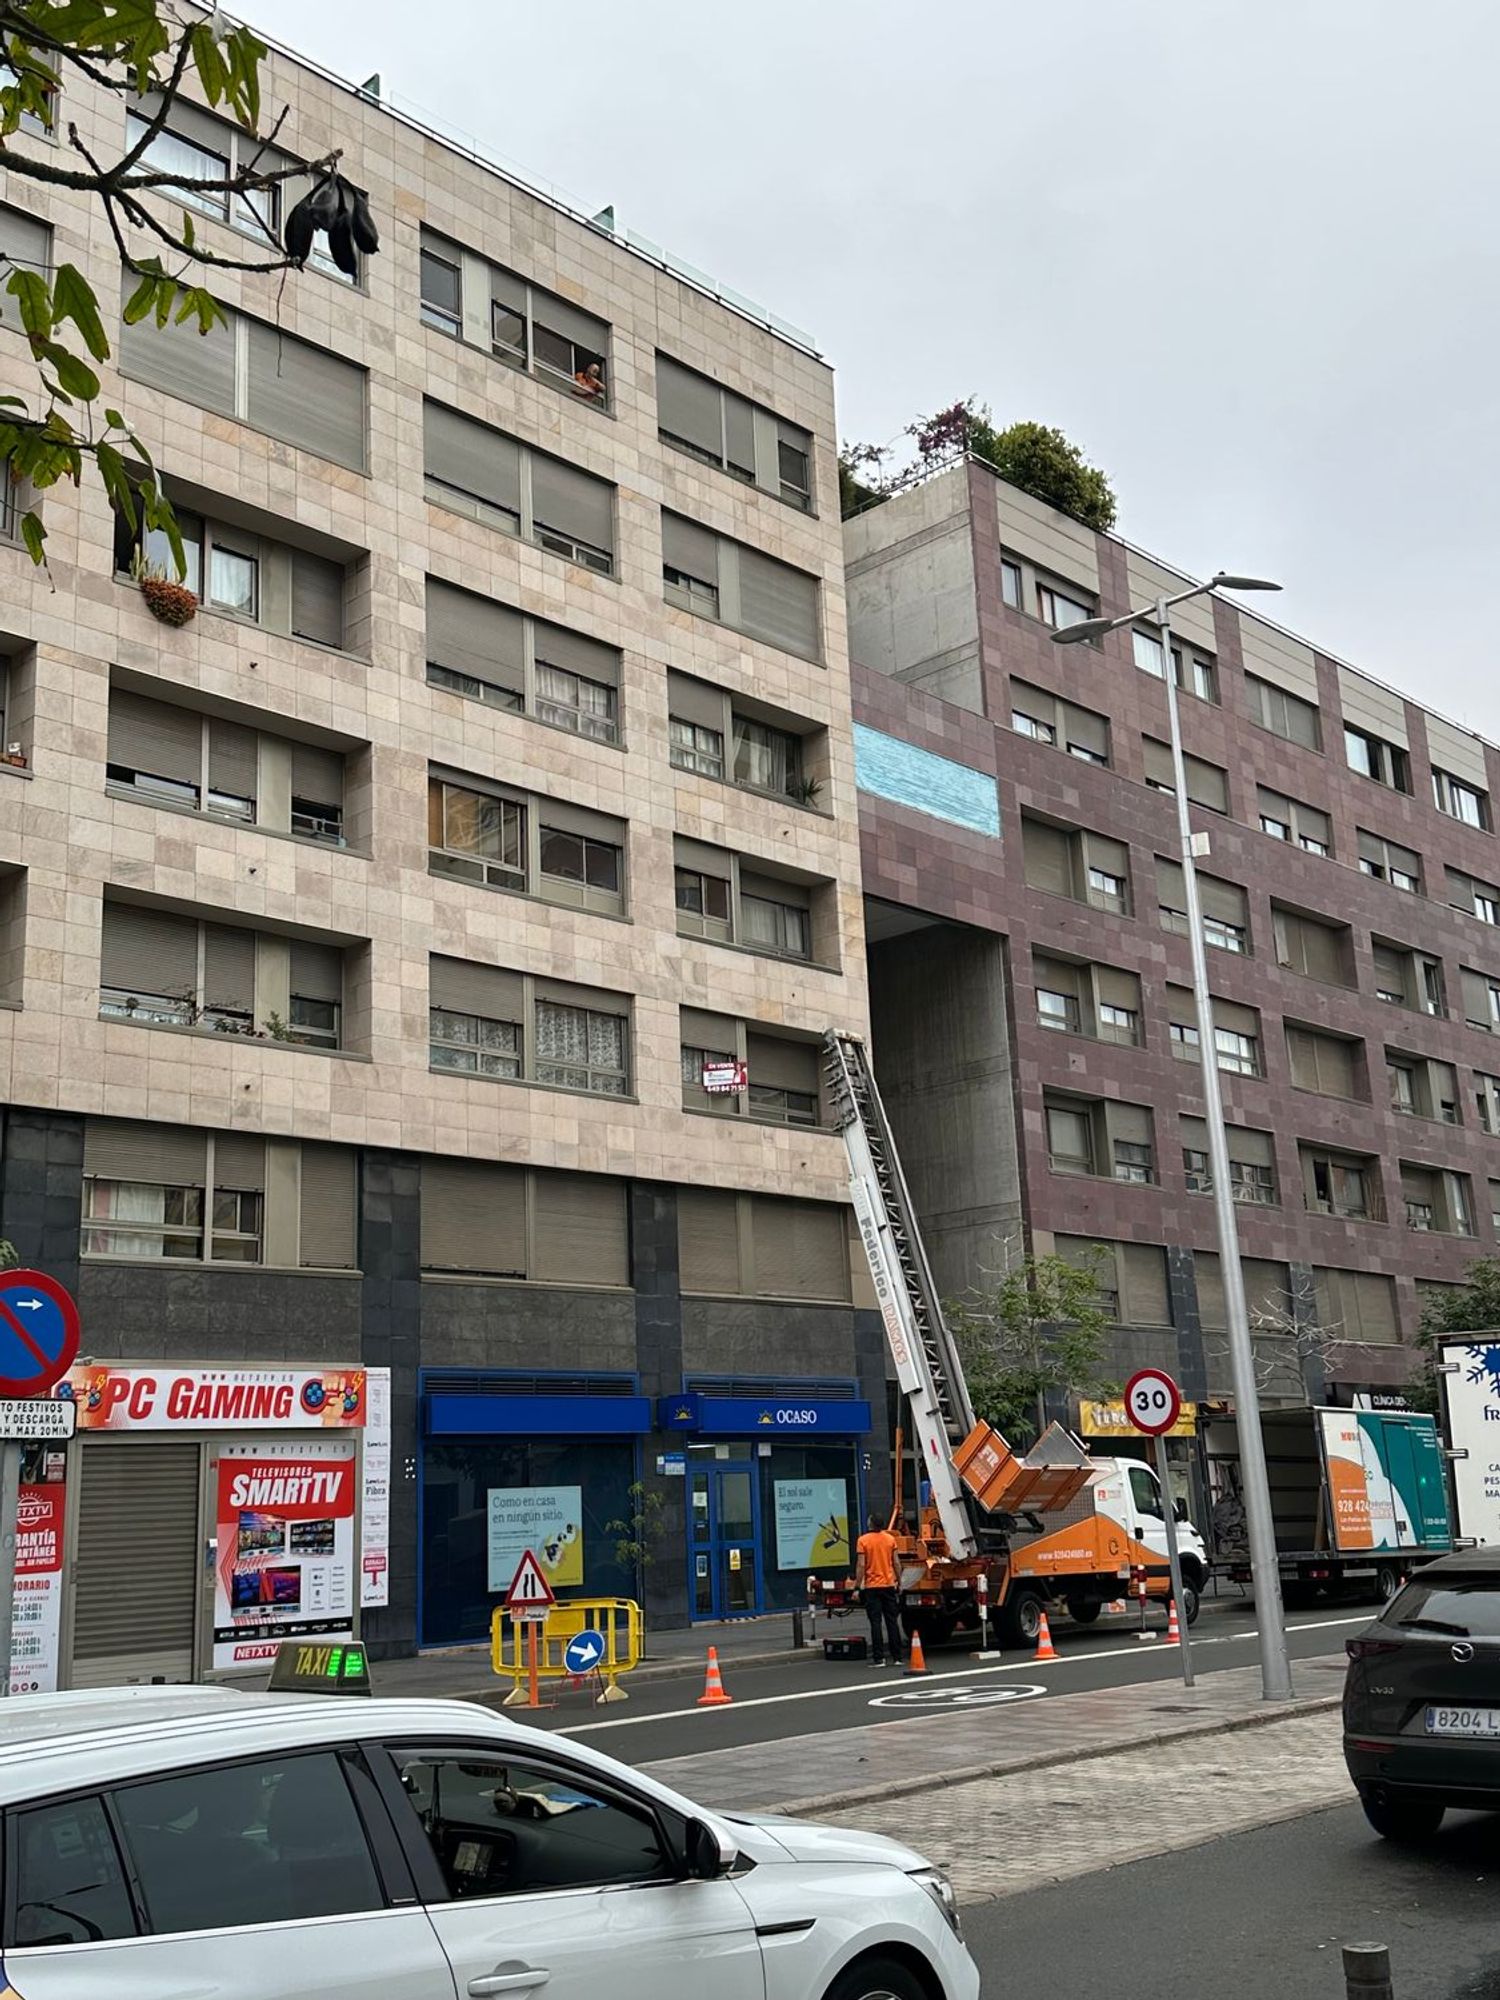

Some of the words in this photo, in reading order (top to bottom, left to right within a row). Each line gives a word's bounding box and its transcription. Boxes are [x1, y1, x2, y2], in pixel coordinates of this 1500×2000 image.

[861, 1217, 887, 1298] Federico
[883, 1303, 907, 1365] RAMOS
[105, 1378, 157, 1420] PC
[167, 1378, 294, 1419] GAMING
[1136, 1390, 1167, 1411] 30
[17, 1403, 63, 1412] FESTIVOS
[4, 1415, 10, 1424] Y
[14, 1415, 64, 1424] DESCARGA
[776, 1410, 817, 1424] OCASO
[252, 1466, 312, 1478] TELEVISORES
[366, 1486, 387, 1496] Fibra
[493, 1496, 521, 1508] Como
[523, 1497, 535, 1507] en
[536, 1496, 556, 1506] casa
[493, 1512, 505, 1523] en
[236, 1644, 279, 1659] NETXTV
[296, 1647, 331, 1676] TAXI
[1439, 1710, 1481, 1729] 8204
[1488, 1713, 1498, 1730] L
